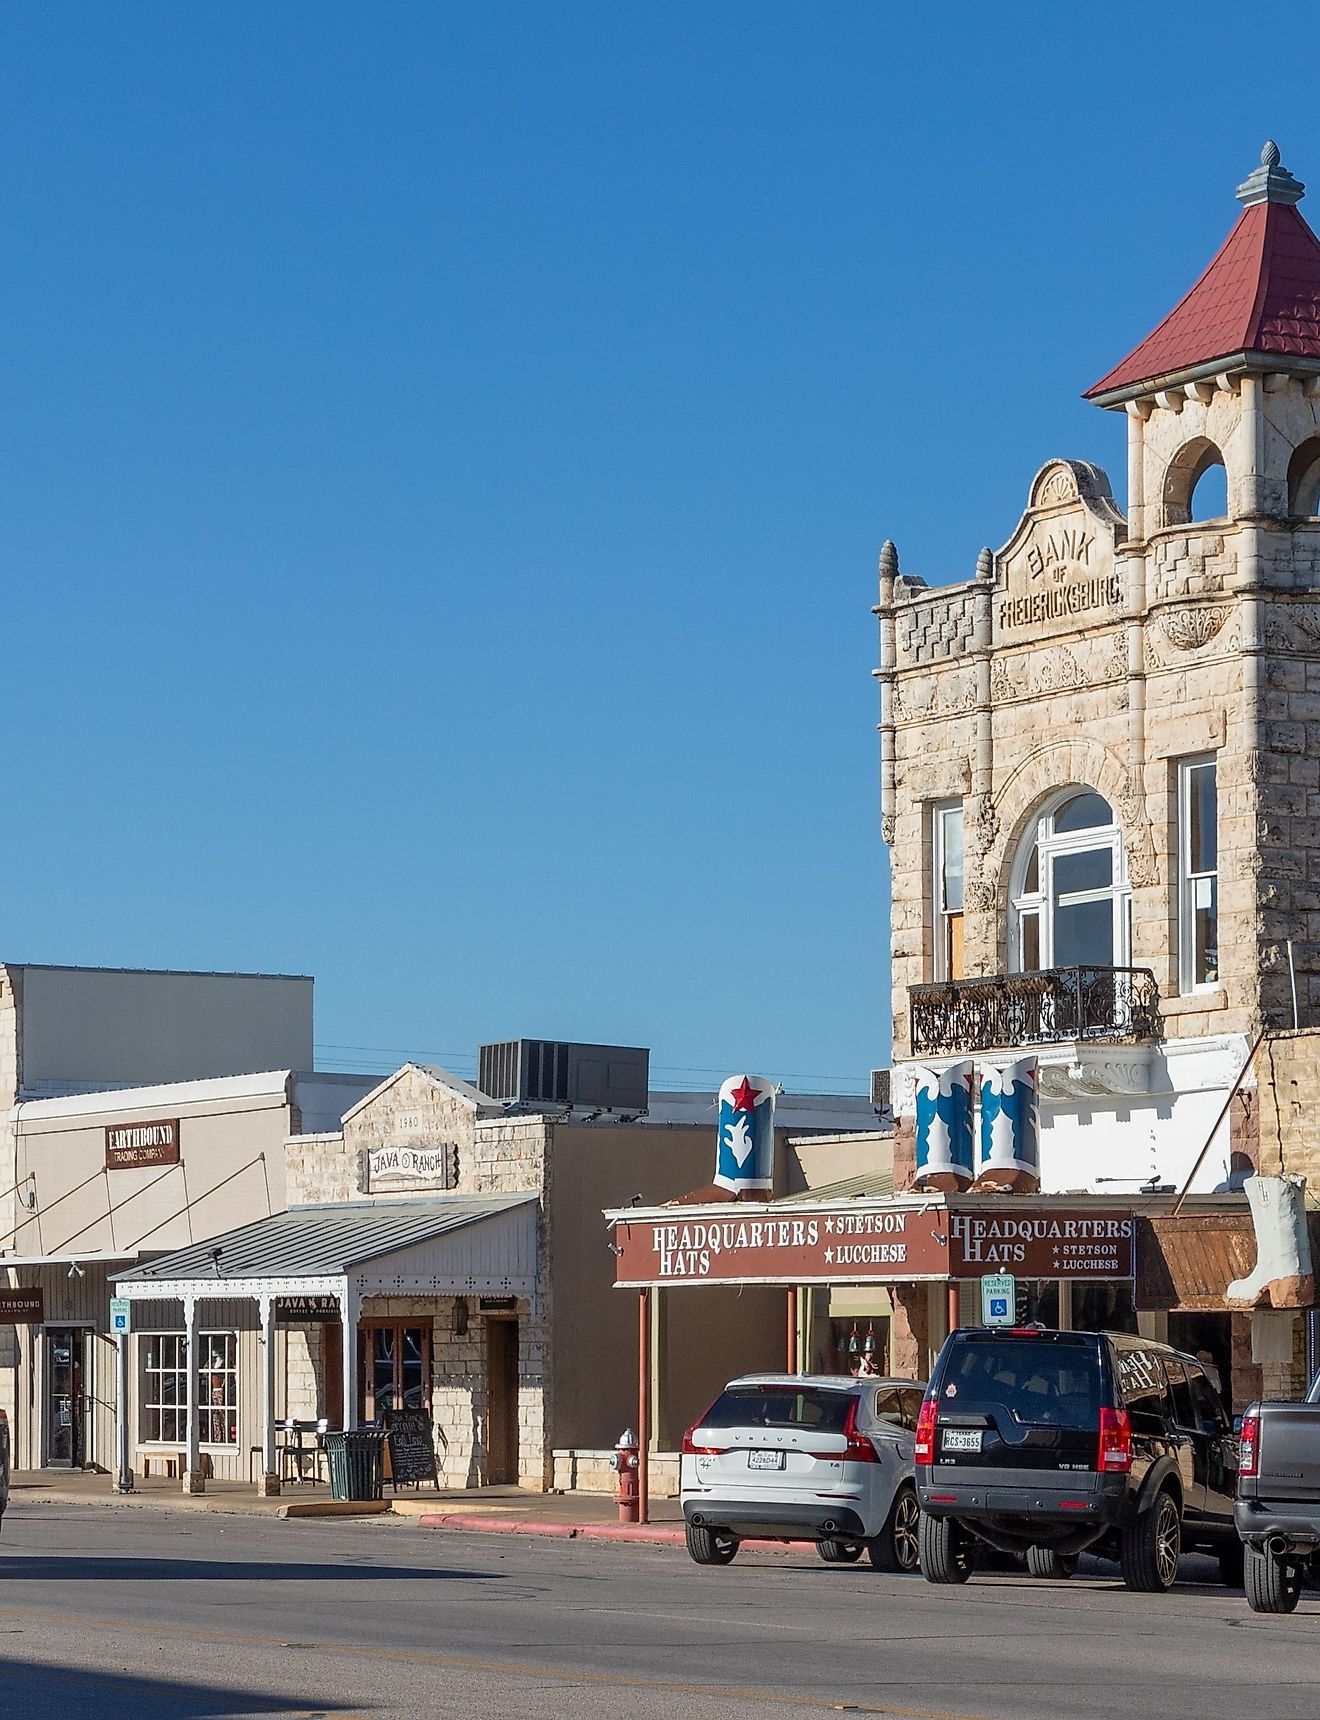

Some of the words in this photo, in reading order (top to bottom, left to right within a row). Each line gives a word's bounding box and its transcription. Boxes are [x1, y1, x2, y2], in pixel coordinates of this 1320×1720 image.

[1027, 529, 1095, 580] BANK
[1053, 566, 1067, 583] OF
[108, 1125, 173, 1150] EARTHBOUND
[114, 1150, 138, 1162] TRADING
[373, 1151, 399, 1173] JAVA
[409, 1151, 441, 1173] RANCH
[836, 1214, 906, 1234] STETSON
[950, 1215, 1133, 1242] HEADQUARTERS
[652, 1220, 819, 1254] HEADQUARTERS
[836, 1244, 907, 1264] LUCCHESE
[962, 1239, 1026, 1262] HATS
[1062, 1245, 1118, 1255] STETSON
[658, 1245, 711, 1276] HATS
[1062, 1259, 1119, 1270] LUCCHESE
[277, 1297, 306, 1308] JAVA
[734, 1435, 797, 1443] VOLVO
